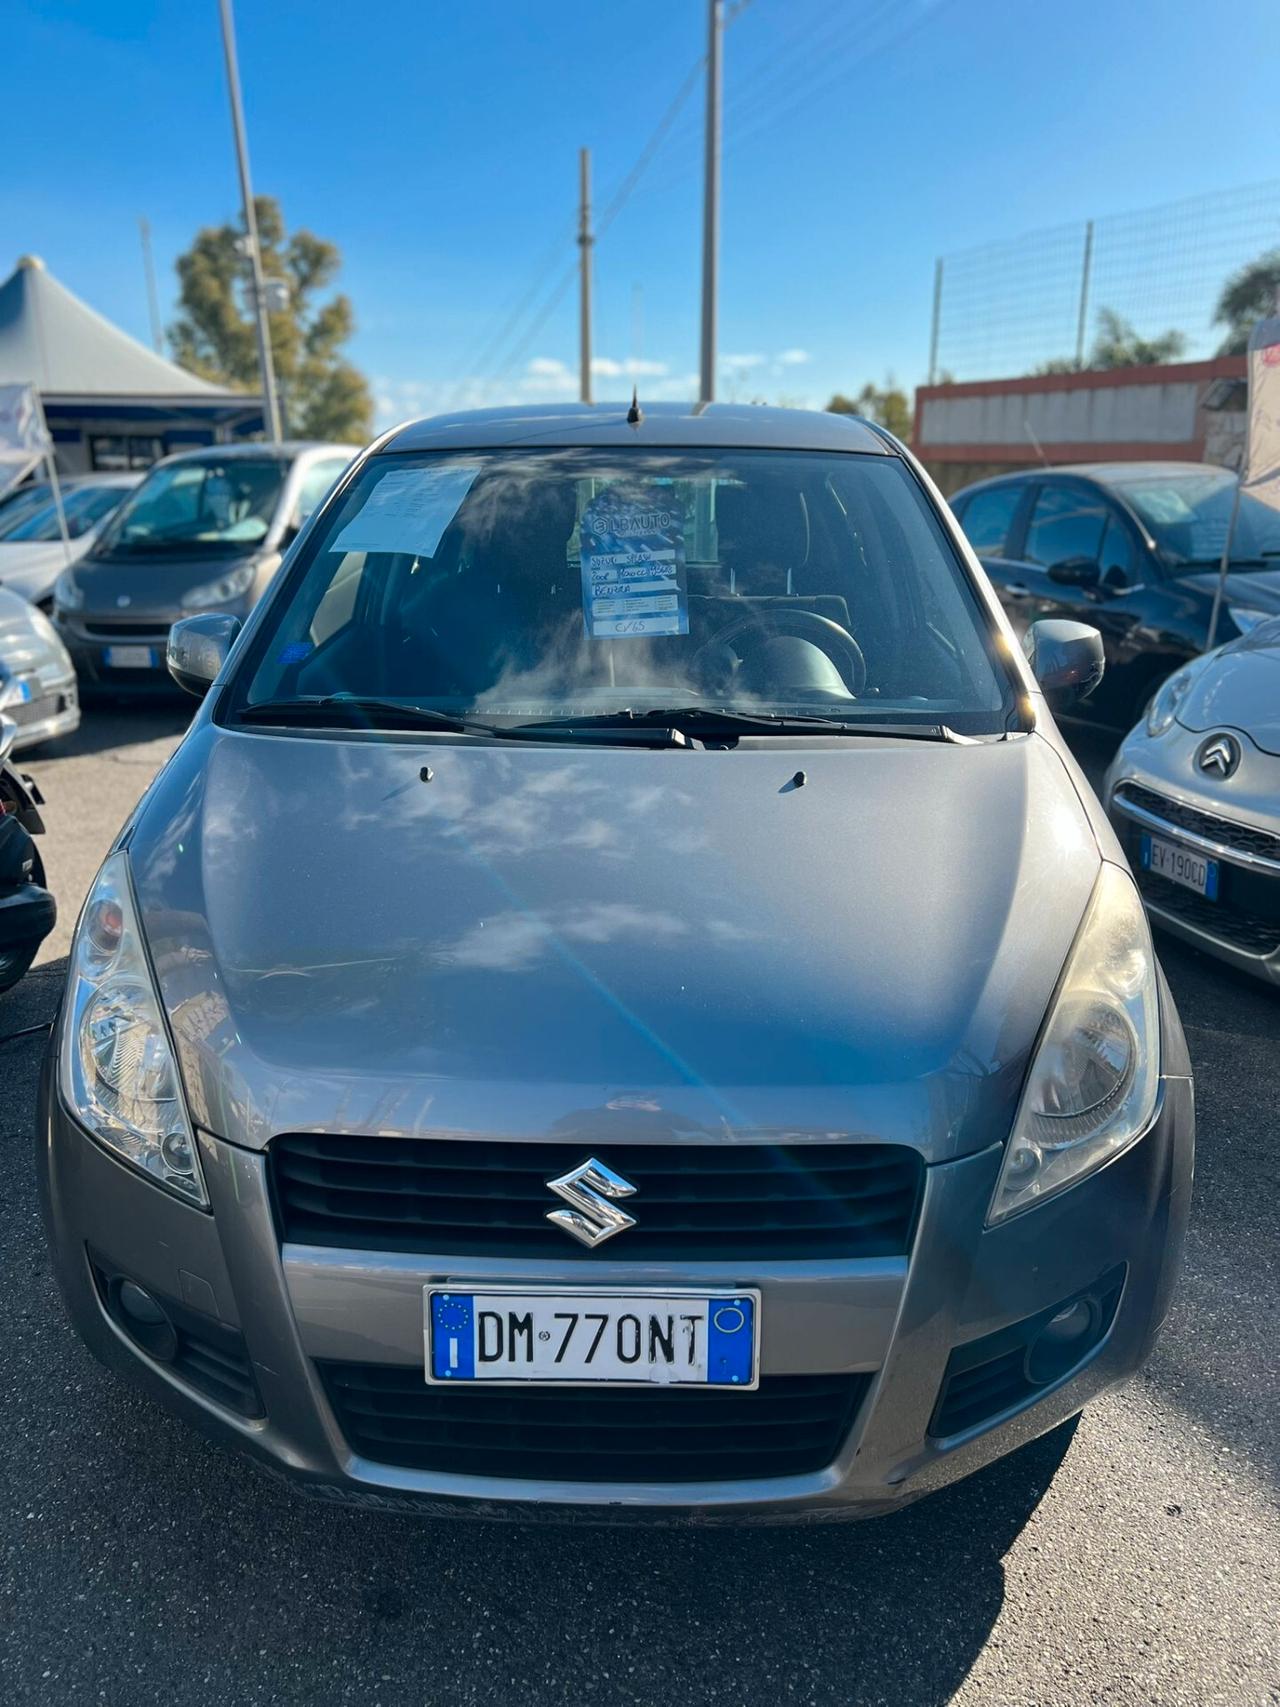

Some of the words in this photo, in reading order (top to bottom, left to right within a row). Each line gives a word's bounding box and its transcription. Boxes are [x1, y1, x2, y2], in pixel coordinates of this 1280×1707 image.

[1151, 844, 1167, 869] EV
[1171, 851, 1206, 887] 190CD
[477, 1311, 534, 1363] DM
[553, 1313, 705, 1366] 770NT
